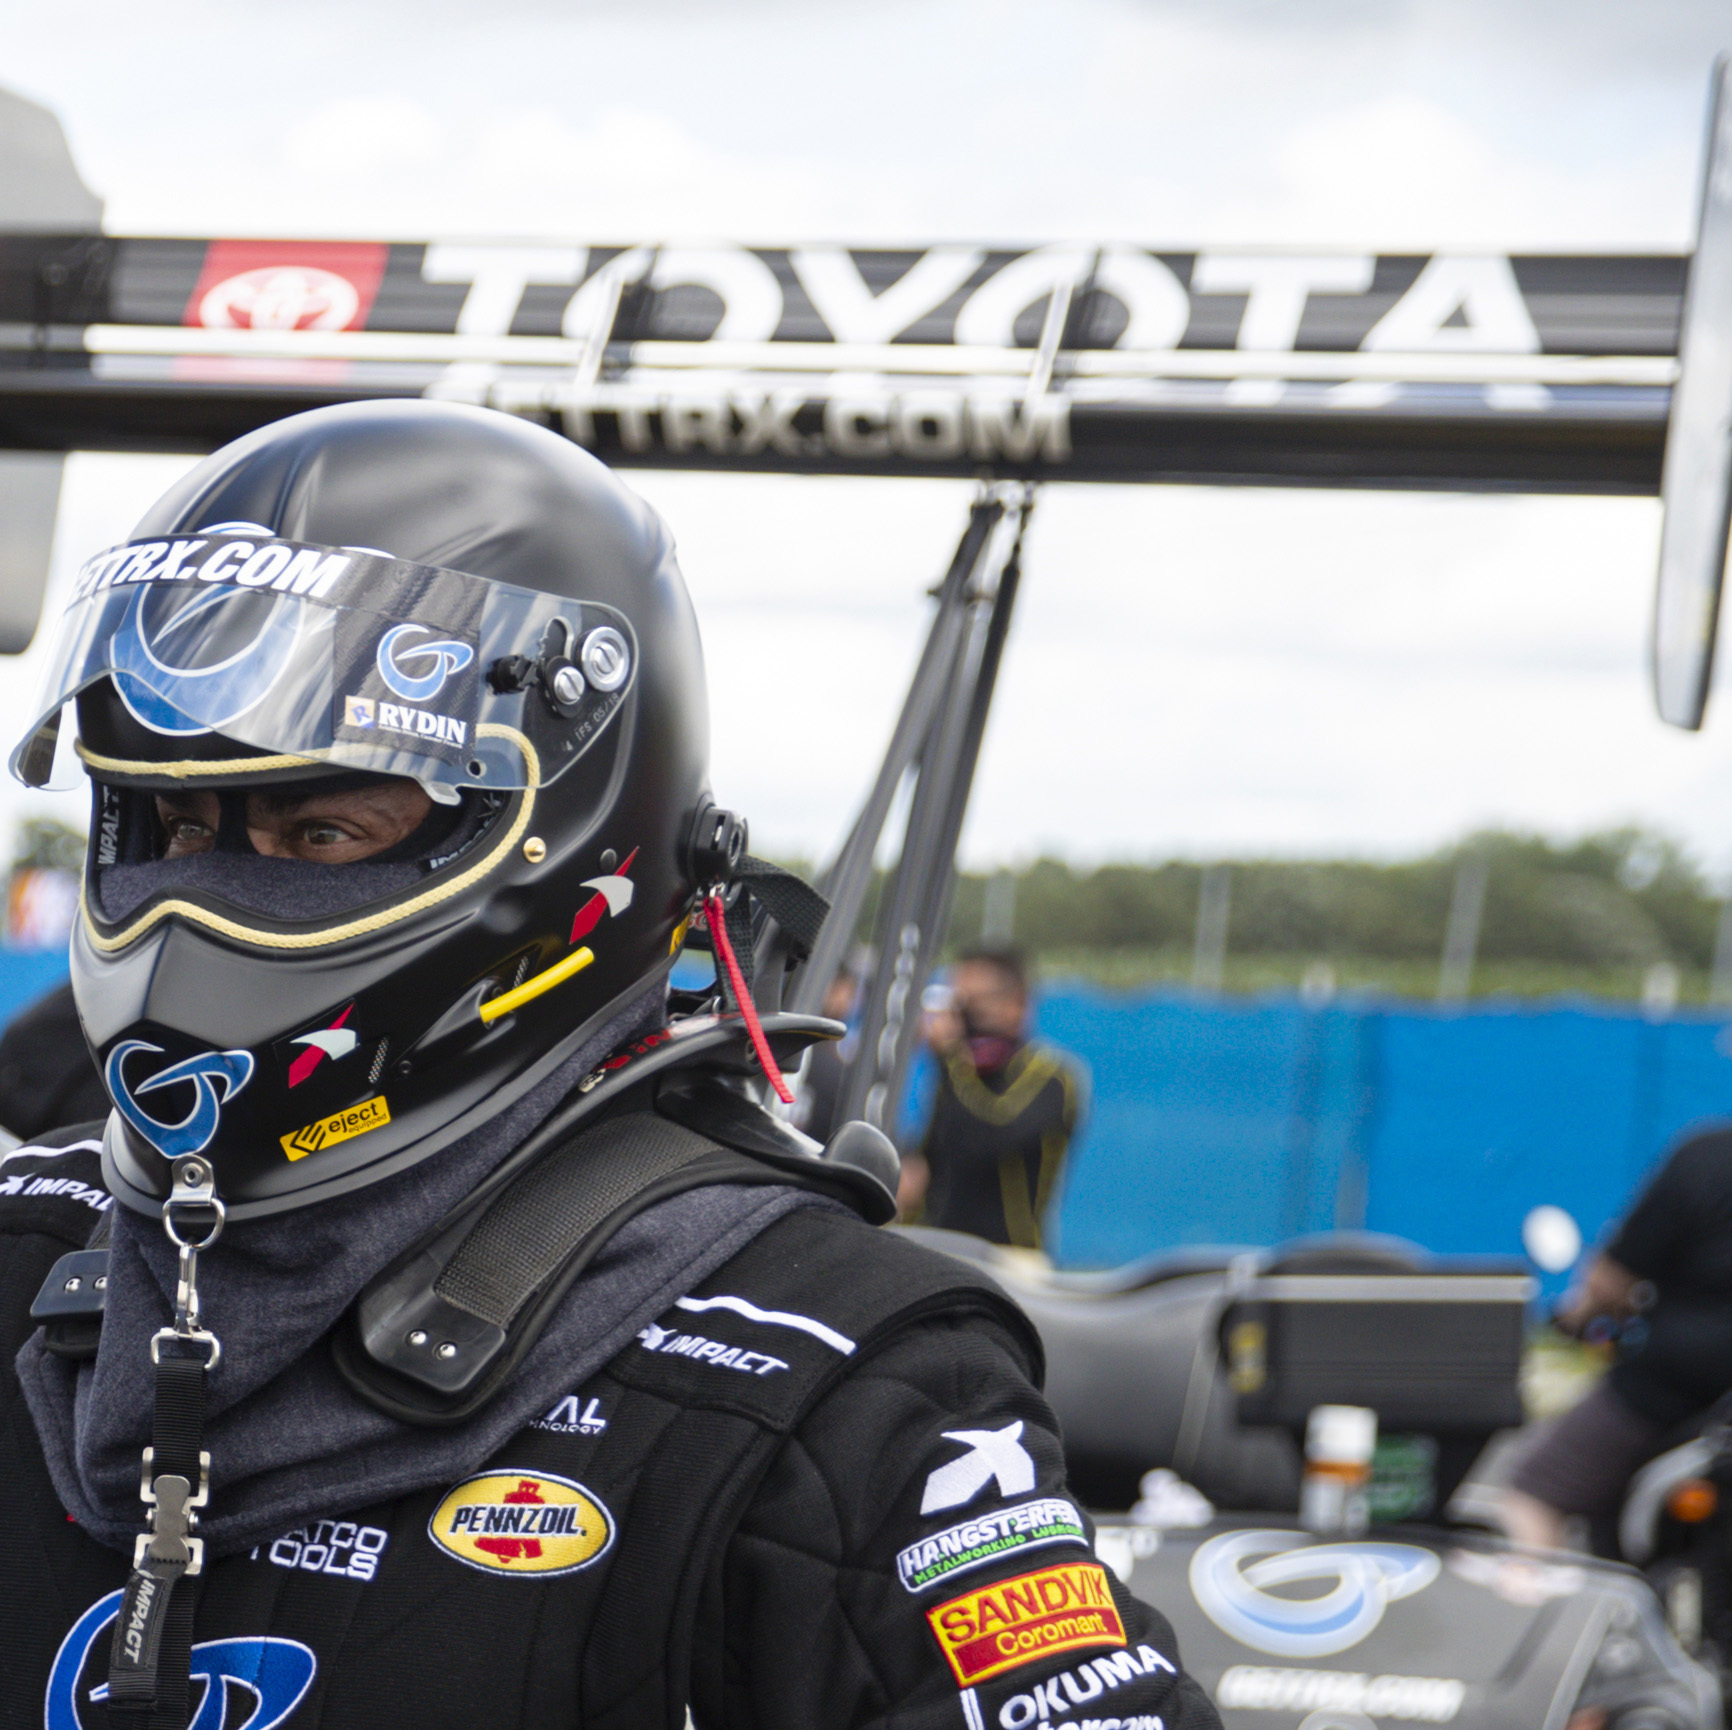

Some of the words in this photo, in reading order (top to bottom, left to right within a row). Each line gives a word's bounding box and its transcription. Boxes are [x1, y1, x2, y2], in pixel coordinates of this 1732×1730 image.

[422, 240, 1552, 410] TOYOTA
[378, 701, 468, 745] RYDIN
[328, 1102, 379, 1133] eject
[659, 1334, 790, 1376] IMPACT
[914, 1533, 1027, 1585] METALWORKING
[124, 1578, 157, 1665] IMPACT
[940, 1570, 1112, 1642] SANDVIK
[995, 1612, 1108, 1656] Coromant
